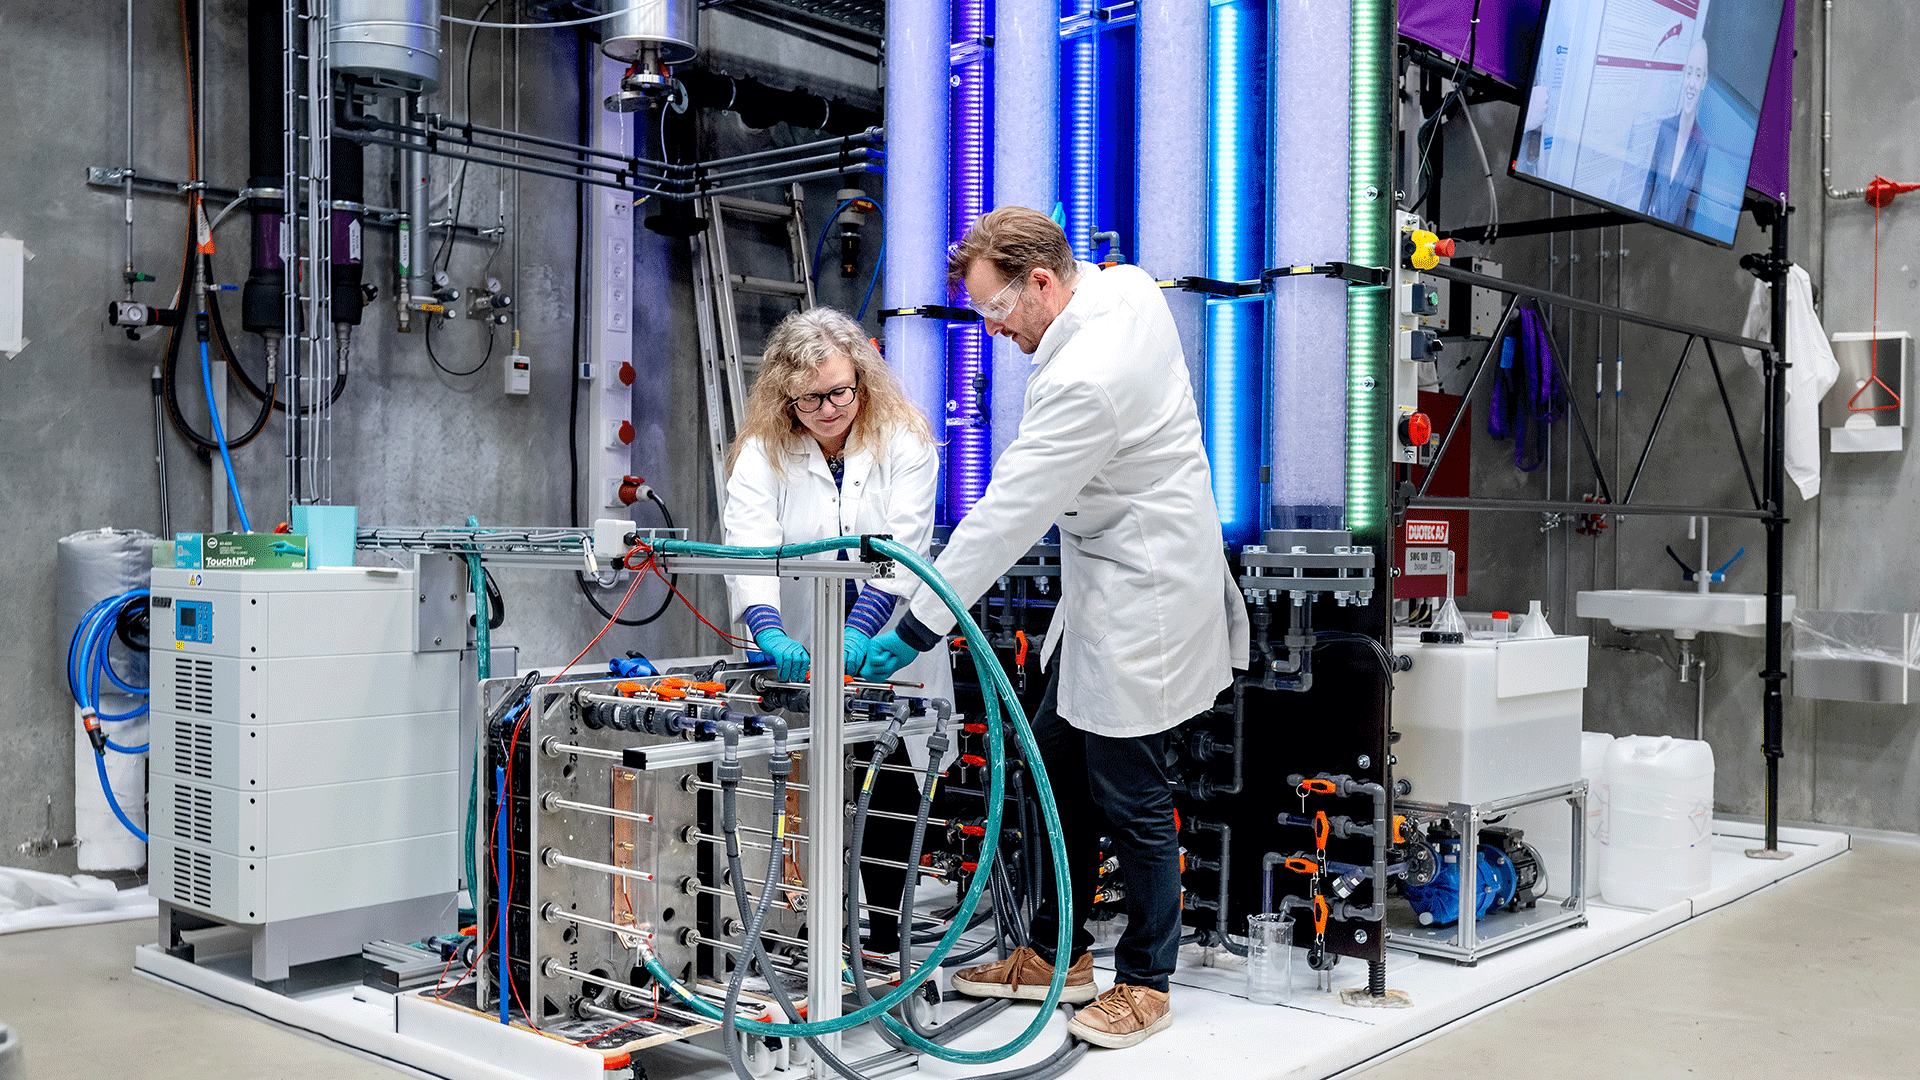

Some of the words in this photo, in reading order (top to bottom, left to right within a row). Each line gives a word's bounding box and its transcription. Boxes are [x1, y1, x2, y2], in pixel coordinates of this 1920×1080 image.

[1408, 525, 1436, 540] DUOTEC
[1435, 525, 1445, 540] AS
[1420, 552, 1428, 561] 100
[205, 557, 255, 567] TouchNTuff
